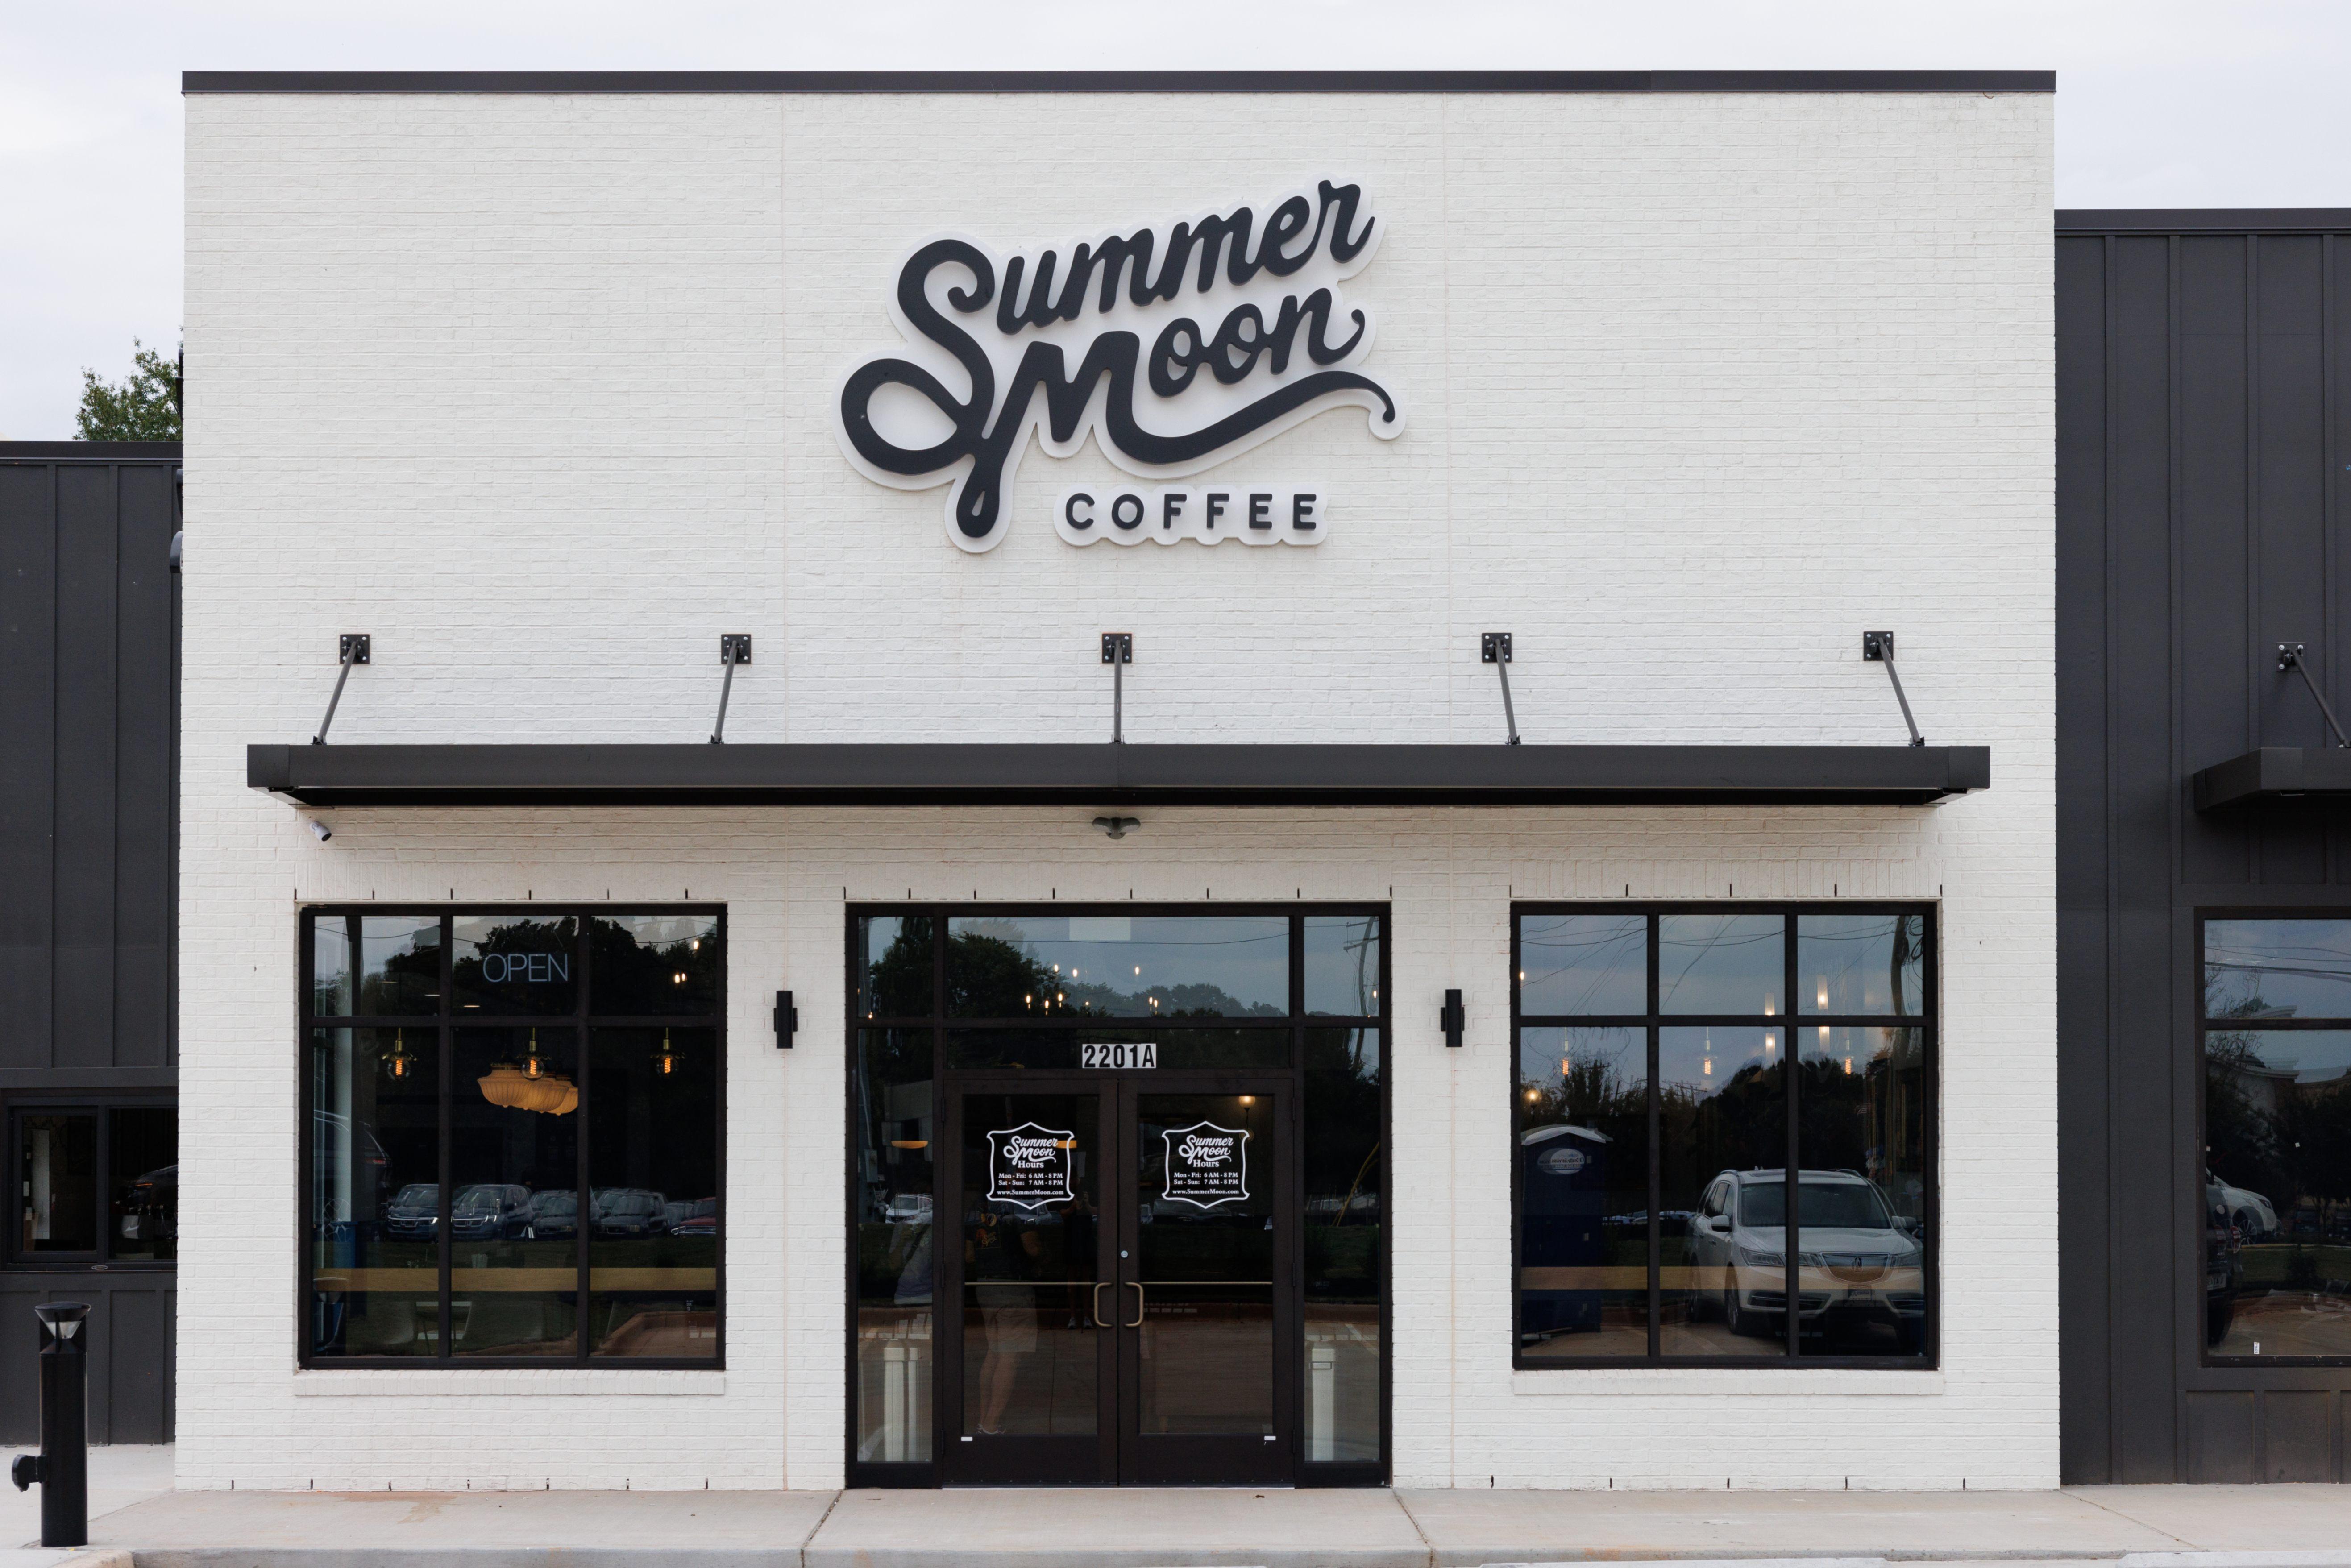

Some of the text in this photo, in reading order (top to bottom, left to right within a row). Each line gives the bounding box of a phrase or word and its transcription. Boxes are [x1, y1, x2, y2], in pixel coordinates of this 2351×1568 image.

[841, 179, 1375, 476] Summer
[955, 287, 1396, 538] Moon
[1065, 493, 1317, 531] COFFEE
[482, 953, 568, 982] OPEN
[1084, 1045, 1155, 1068] 2201A
[1003, 1135, 1059, 1158] Summer
[1012, 1148, 1056, 1165] Moon
[1178, 1134, 1234, 1157] Summer
[1187, 1147, 1232, 1164] Moon
[1018, 1160, 1044, 1168] Hours
[1192, 1159, 1220, 1167] Hours
